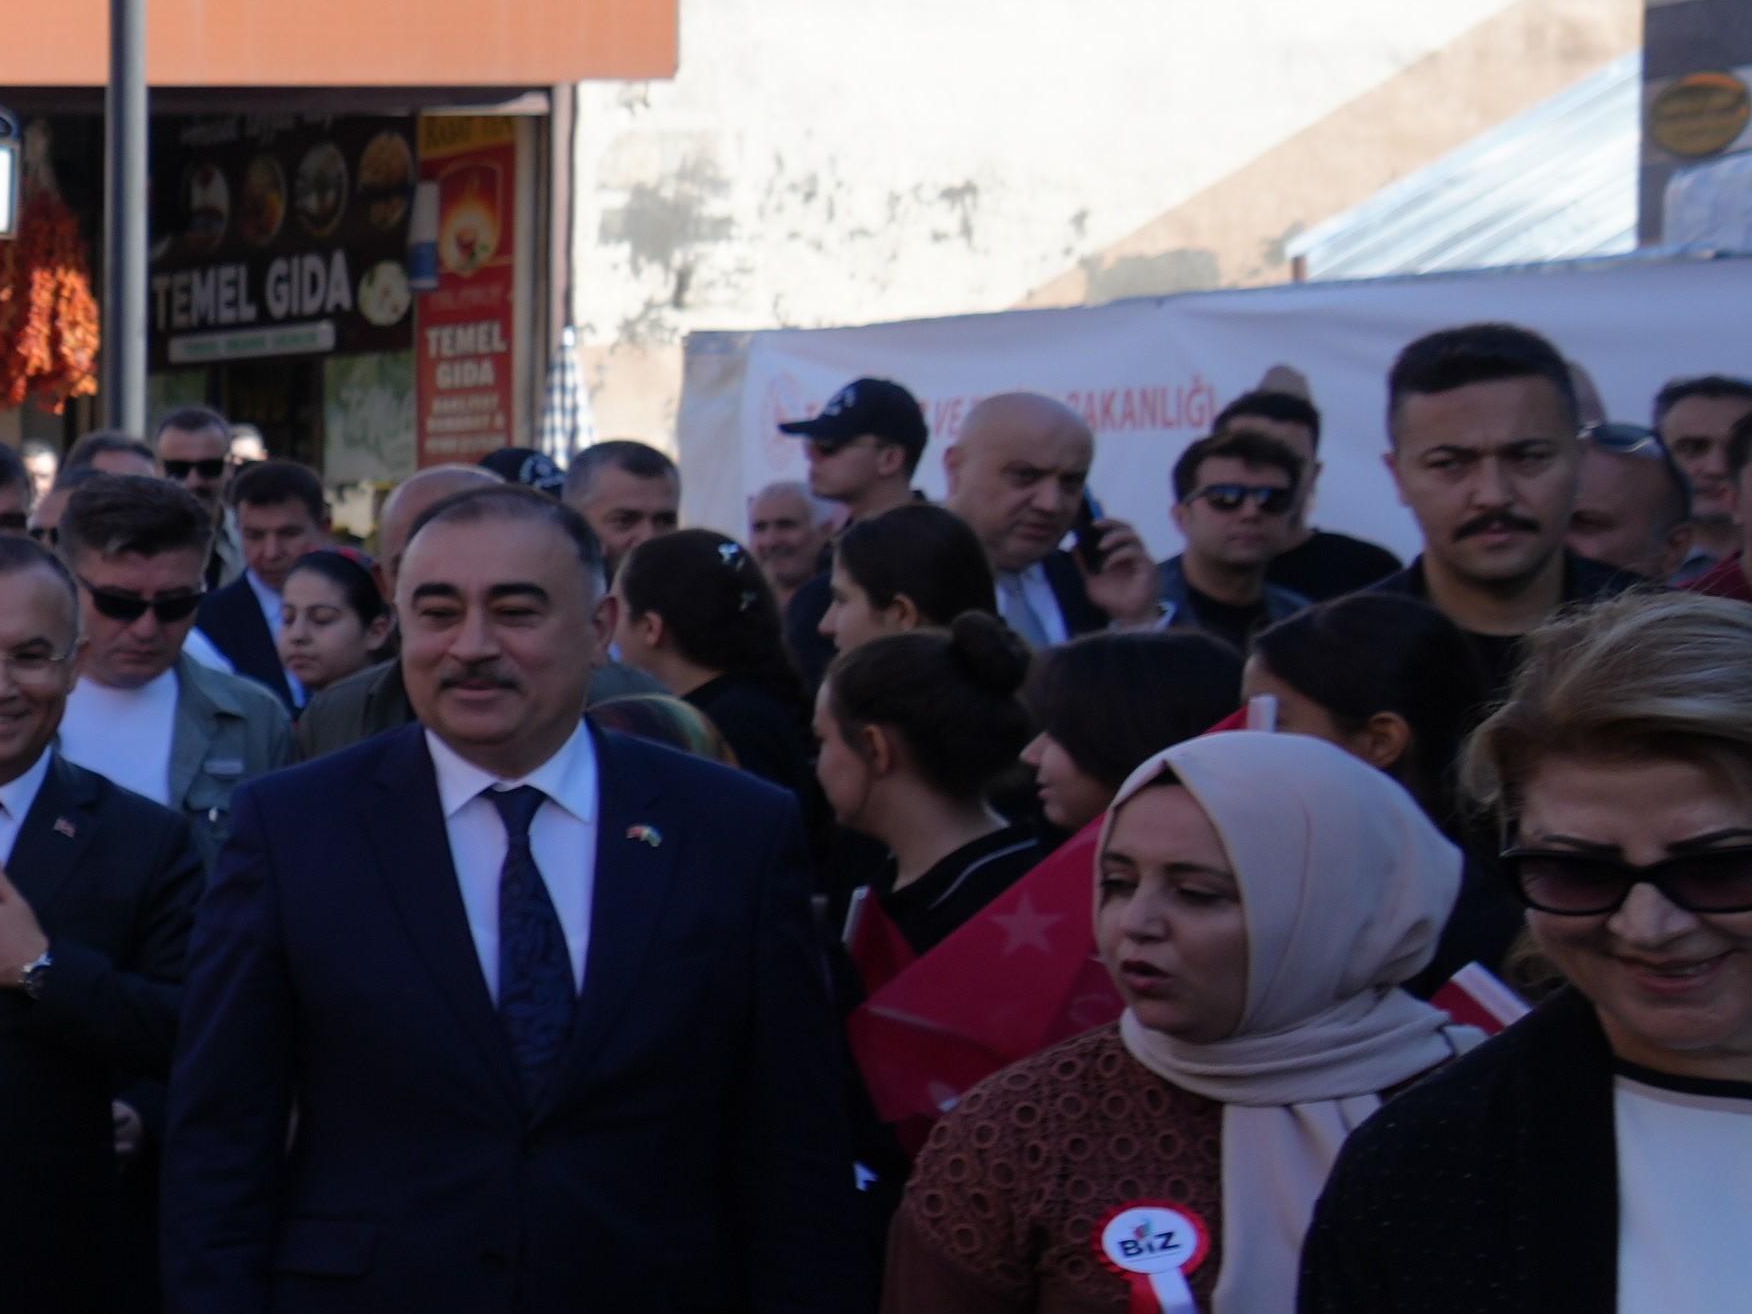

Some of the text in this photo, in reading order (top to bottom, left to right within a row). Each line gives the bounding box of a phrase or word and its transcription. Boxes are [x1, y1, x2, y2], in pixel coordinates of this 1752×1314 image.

[152, 262, 257, 331] TEMEL
[265, 248, 353, 319] GIDA
[425, 321, 509, 359] TEMEL
[436, 359, 496, 390] GIDA
